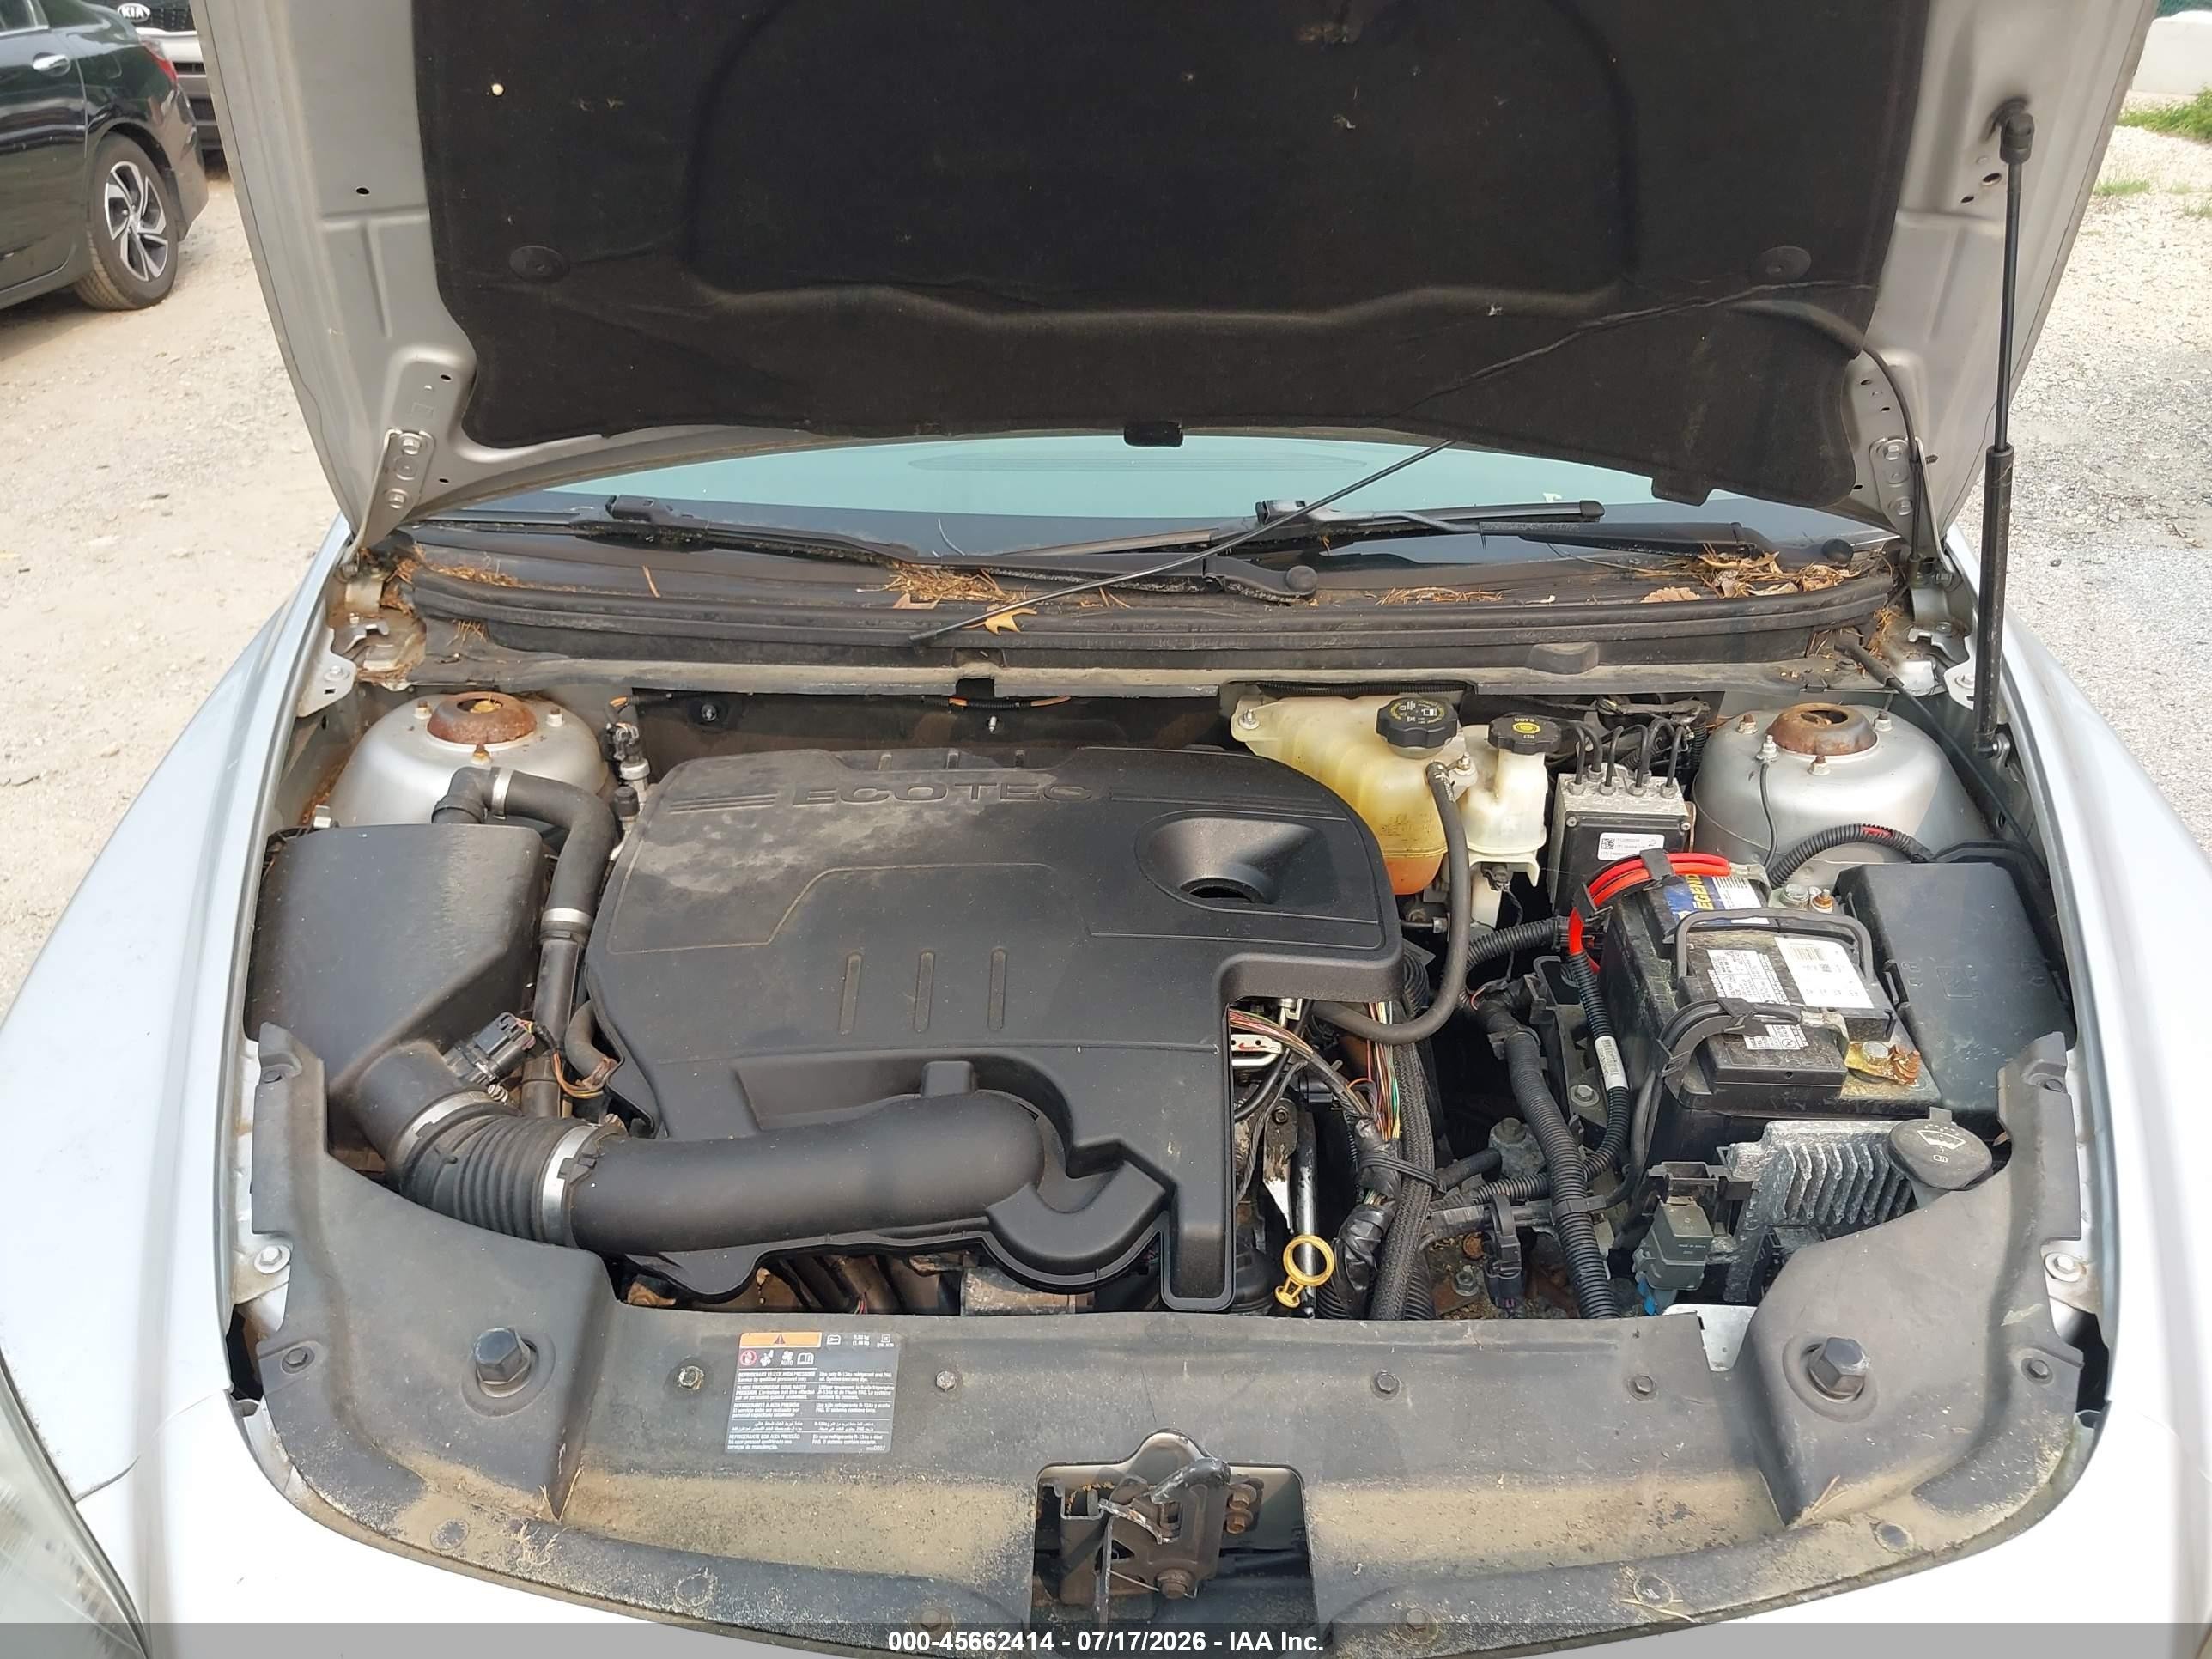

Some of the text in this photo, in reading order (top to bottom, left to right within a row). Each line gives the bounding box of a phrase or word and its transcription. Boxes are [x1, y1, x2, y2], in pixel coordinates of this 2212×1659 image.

[122, 6, 144, 18] KIA
[792, 782, 1093, 805] ECOTEC
[1685, 873, 1715, 911] EGEND
